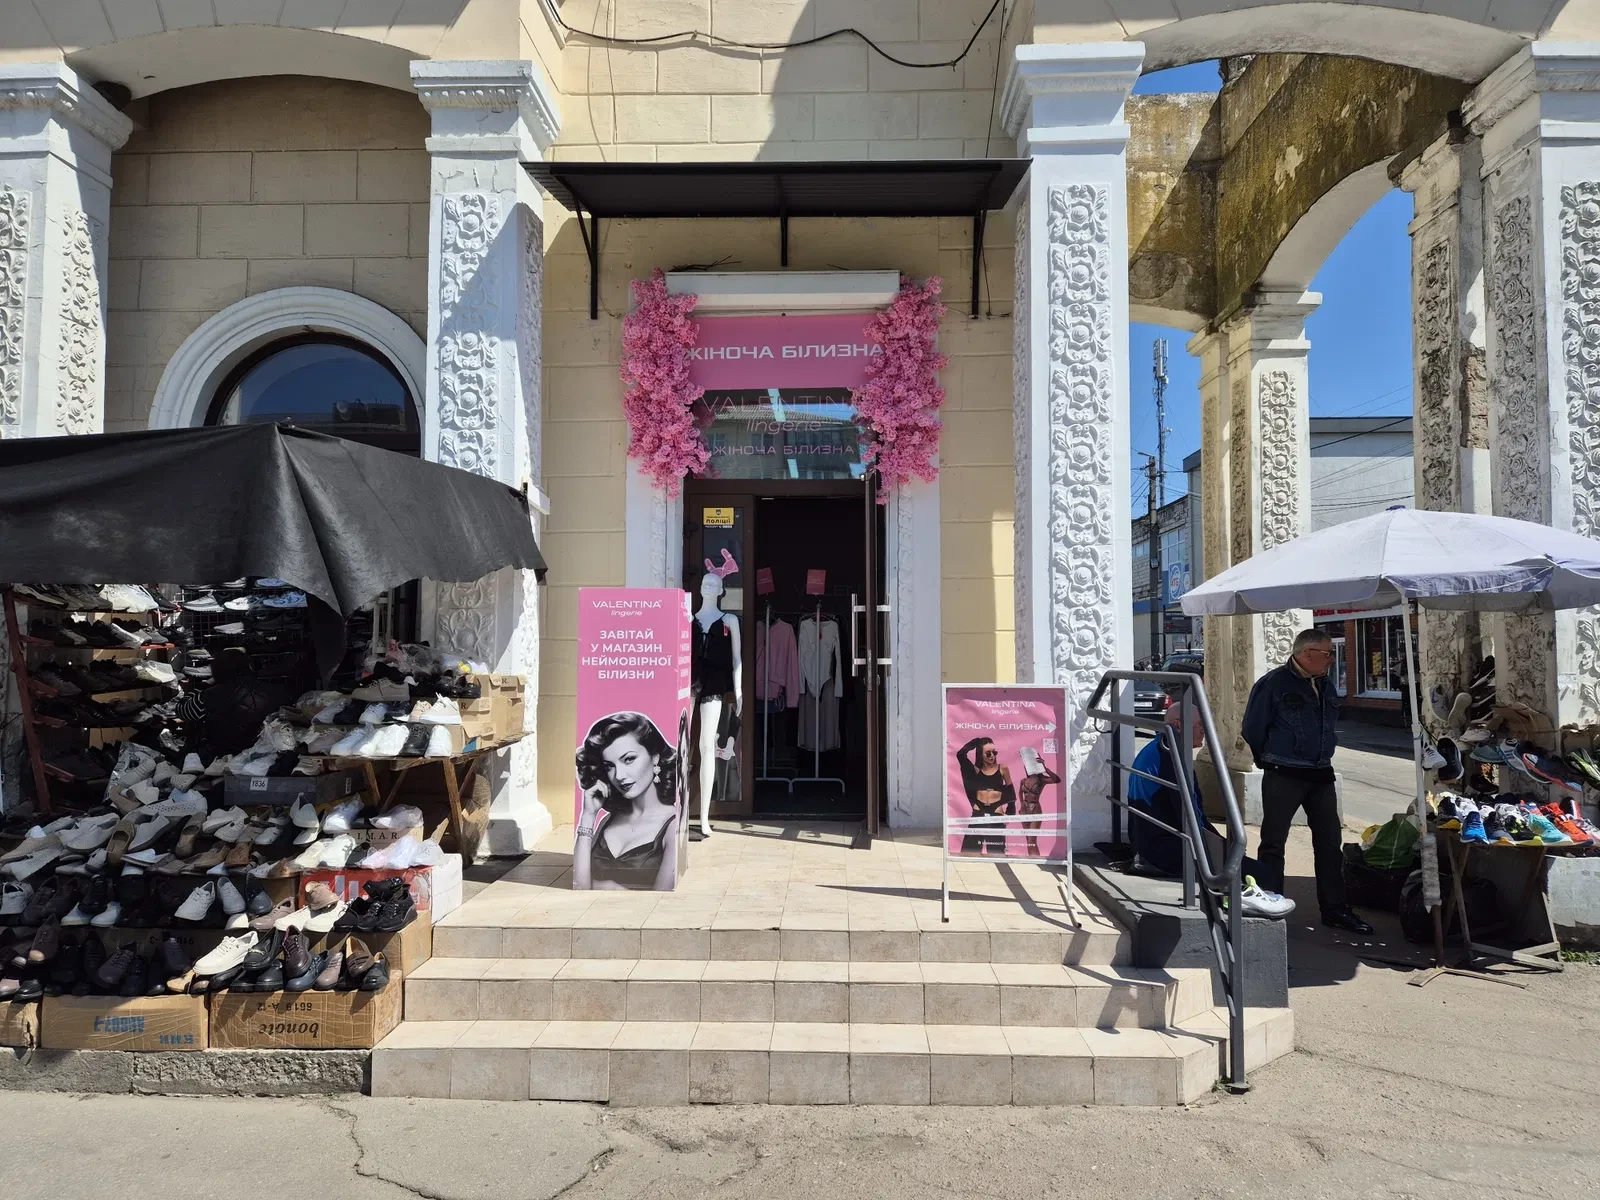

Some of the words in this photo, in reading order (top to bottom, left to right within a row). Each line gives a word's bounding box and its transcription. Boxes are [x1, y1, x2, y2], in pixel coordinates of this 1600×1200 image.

[684, 345, 775, 360] ЖІНОЧА
[781, 343, 884, 359] БІЛИЗНА
[700, 395, 852, 413] VALENTIN
[745, 419, 822, 435] lingerie
[713, 445, 777, 455] ЖІНОЧА
[783, 444, 855, 455] БІЛИЗНА
[592, 600, 661, 608] VALENTINA
[610, 609, 643, 618] lingerie
[599, 628, 654, 640] ЗАВІТАЙ
[590, 643, 600, 653] У
[602, 643, 663, 653] МАГАЗИН
[581, 654, 672, 666] НЕЙМОВІРНОЇ
[598, 670, 655, 680] БІЛИЗНИ
[974, 700, 1037, 708] VALENTINA
[955, 722, 996, 730] ЖІНОЧА
